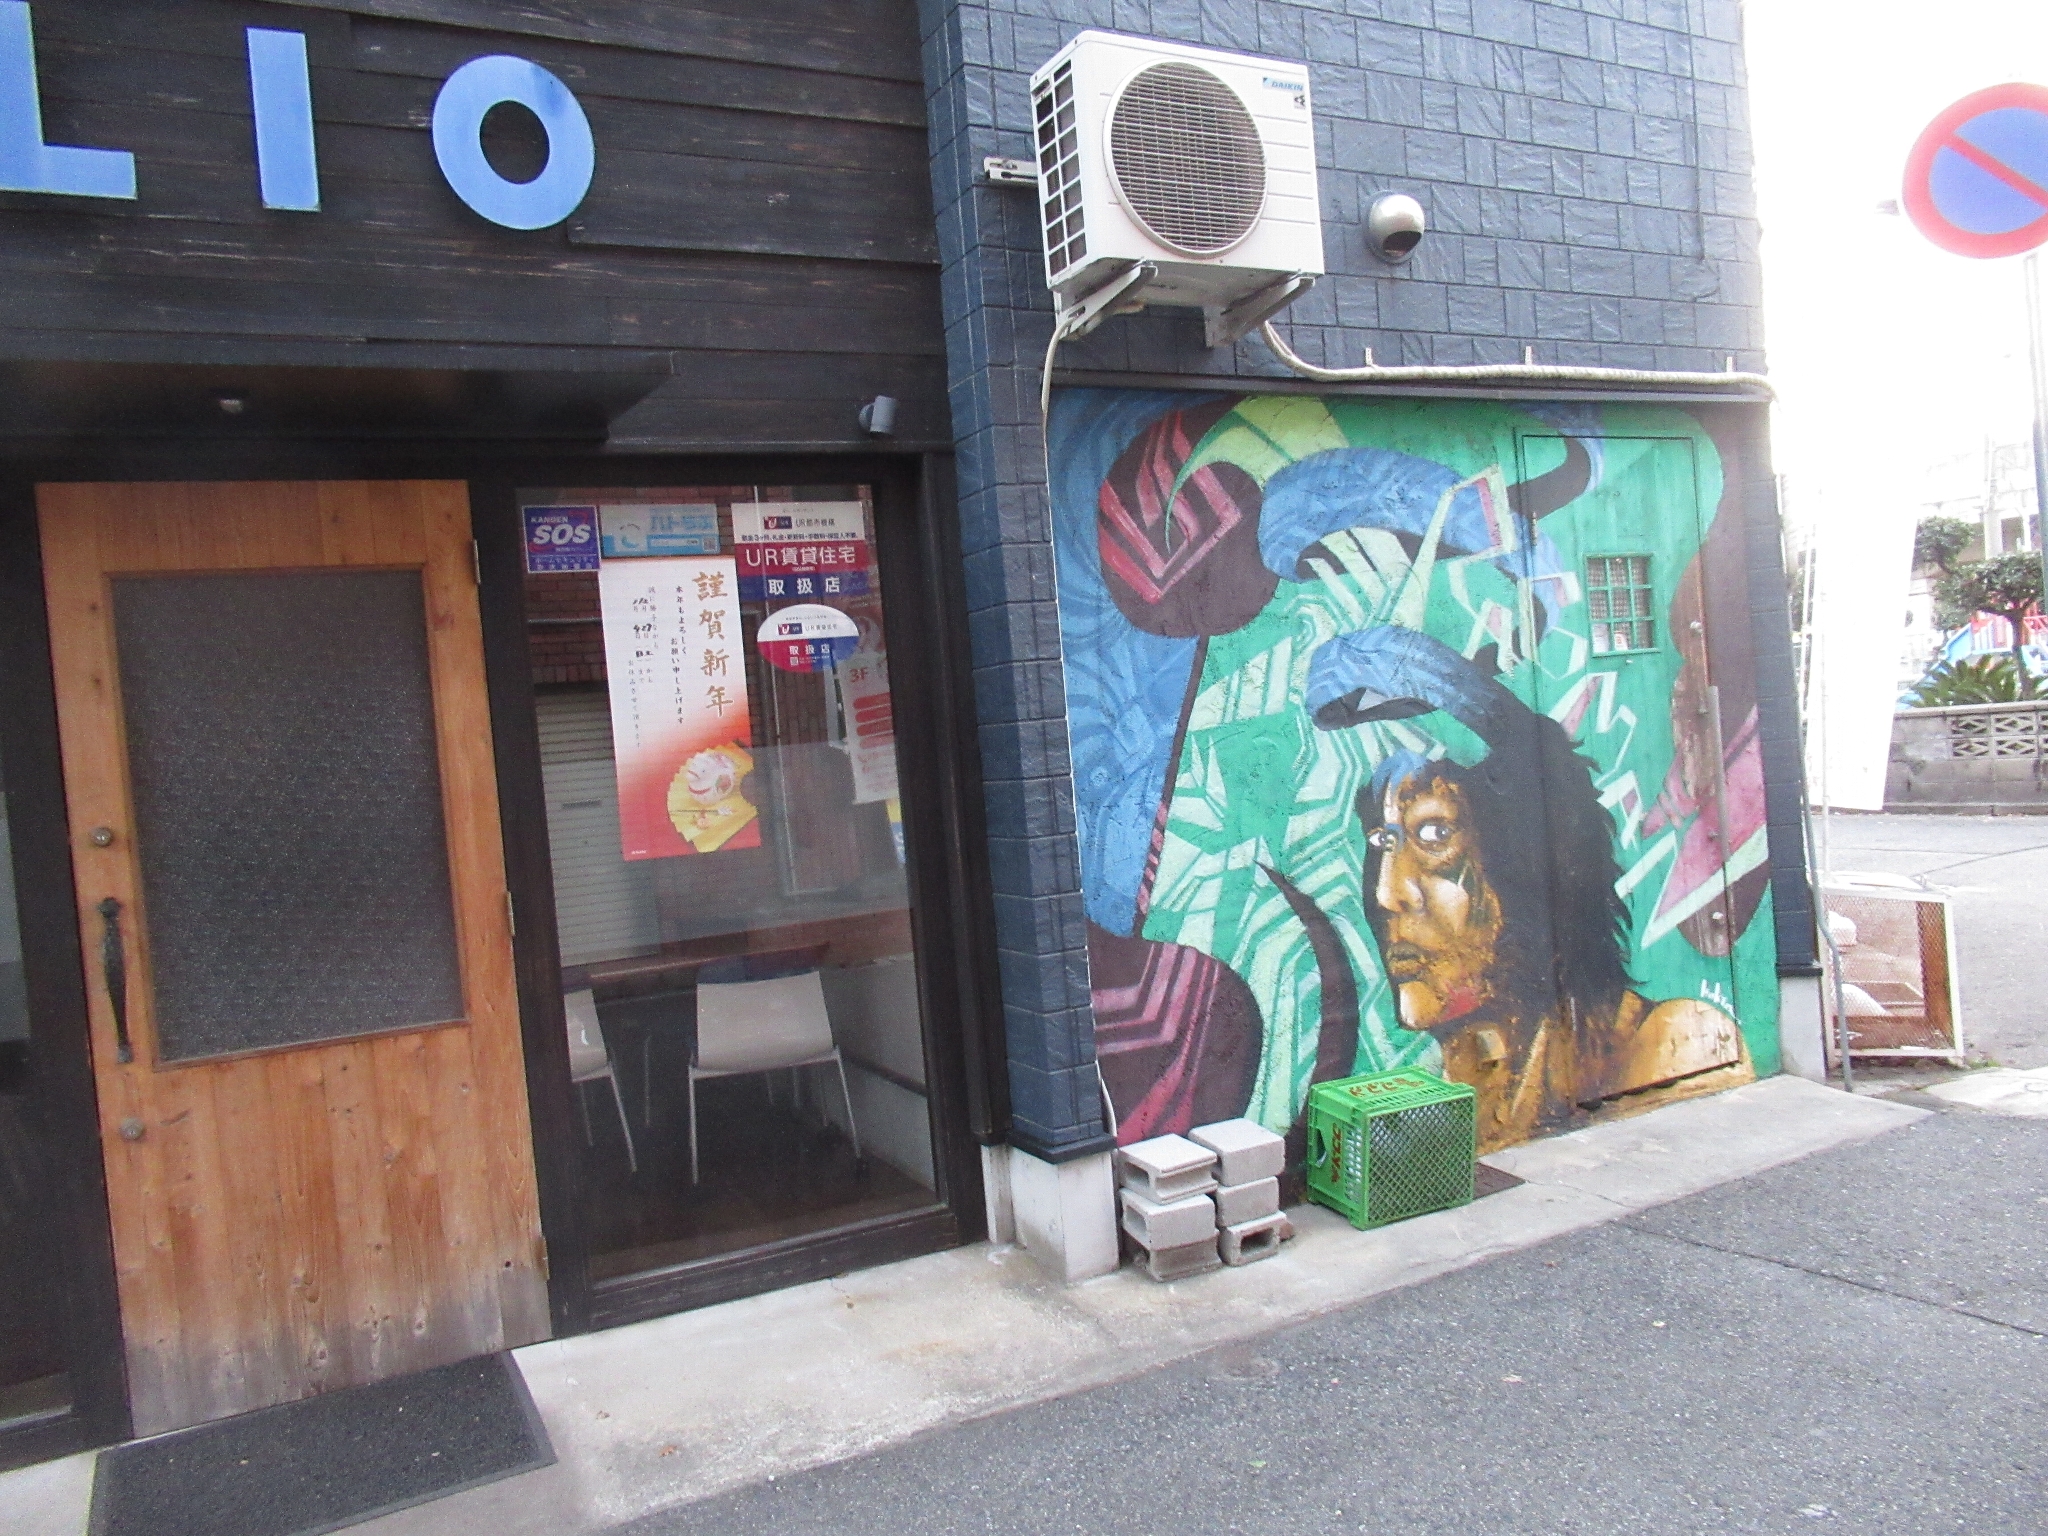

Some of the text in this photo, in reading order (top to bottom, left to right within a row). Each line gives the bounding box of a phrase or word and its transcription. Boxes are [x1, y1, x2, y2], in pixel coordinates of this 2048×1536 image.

[1271, 80, 1304, 92] DAIKIN
[532, 523, 592, 546] SOS
[745, 546, 856, 567] UR賃貸住宅
[768, 576, 841, 596] 取扱店
[691, 570, 734, 718] 謹賀新年
[789, 643, 830, 656] 取扱店
